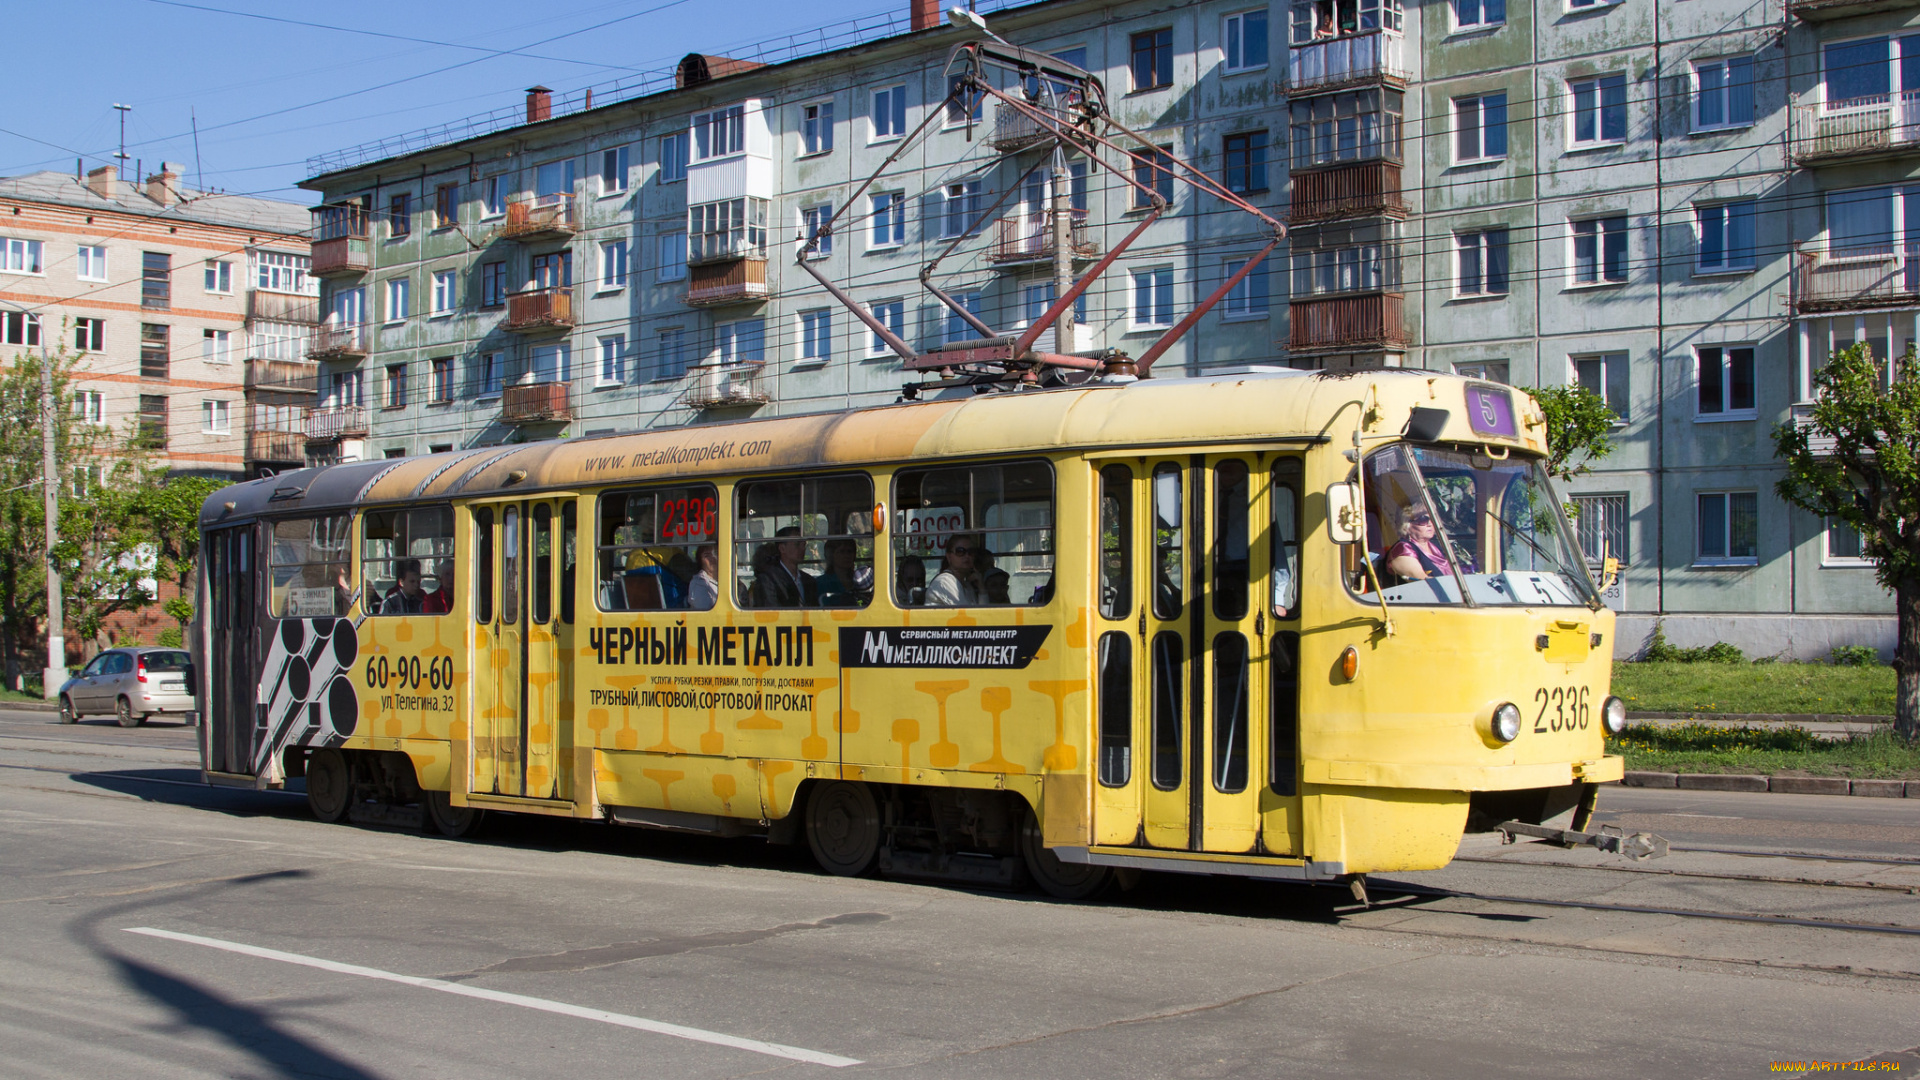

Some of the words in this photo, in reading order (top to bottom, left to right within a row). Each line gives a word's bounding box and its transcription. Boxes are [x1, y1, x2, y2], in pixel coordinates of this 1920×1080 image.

[966, 351, 974, 360] 24
[1477, 392, 1497, 427] 5
[585, 455, 625, 472] www.
[740, 440, 771, 455] com
[662, 497, 715, 537] 2336
[291, 591, 298, 615] 5
[1529, 577, 1553, 604] 5
[590, 620, 687, 665] ЧЕРНЫЙ
[697, 626, 813, 667] МЕТАЛЛ
[900, 628, 949, 639] СЕРВИСНЫЙ
[951, 630, 1017, 640] МЕТАЛЛОЦЕНТР
[893, 645, 1017, 665] МЕТАЛЛКОМПЛЕКТ
[366, 655, 453, 690] 60-90-60
[650, 676, 671, 685] УСЛУГИ
[778, 678, 814, 689] ДОСТАВКИ
[442, 695, 454, 712] 32
[765, 693, 813, 711] ПРОКАТ
[1534, 685, 1589, 734] 2336
